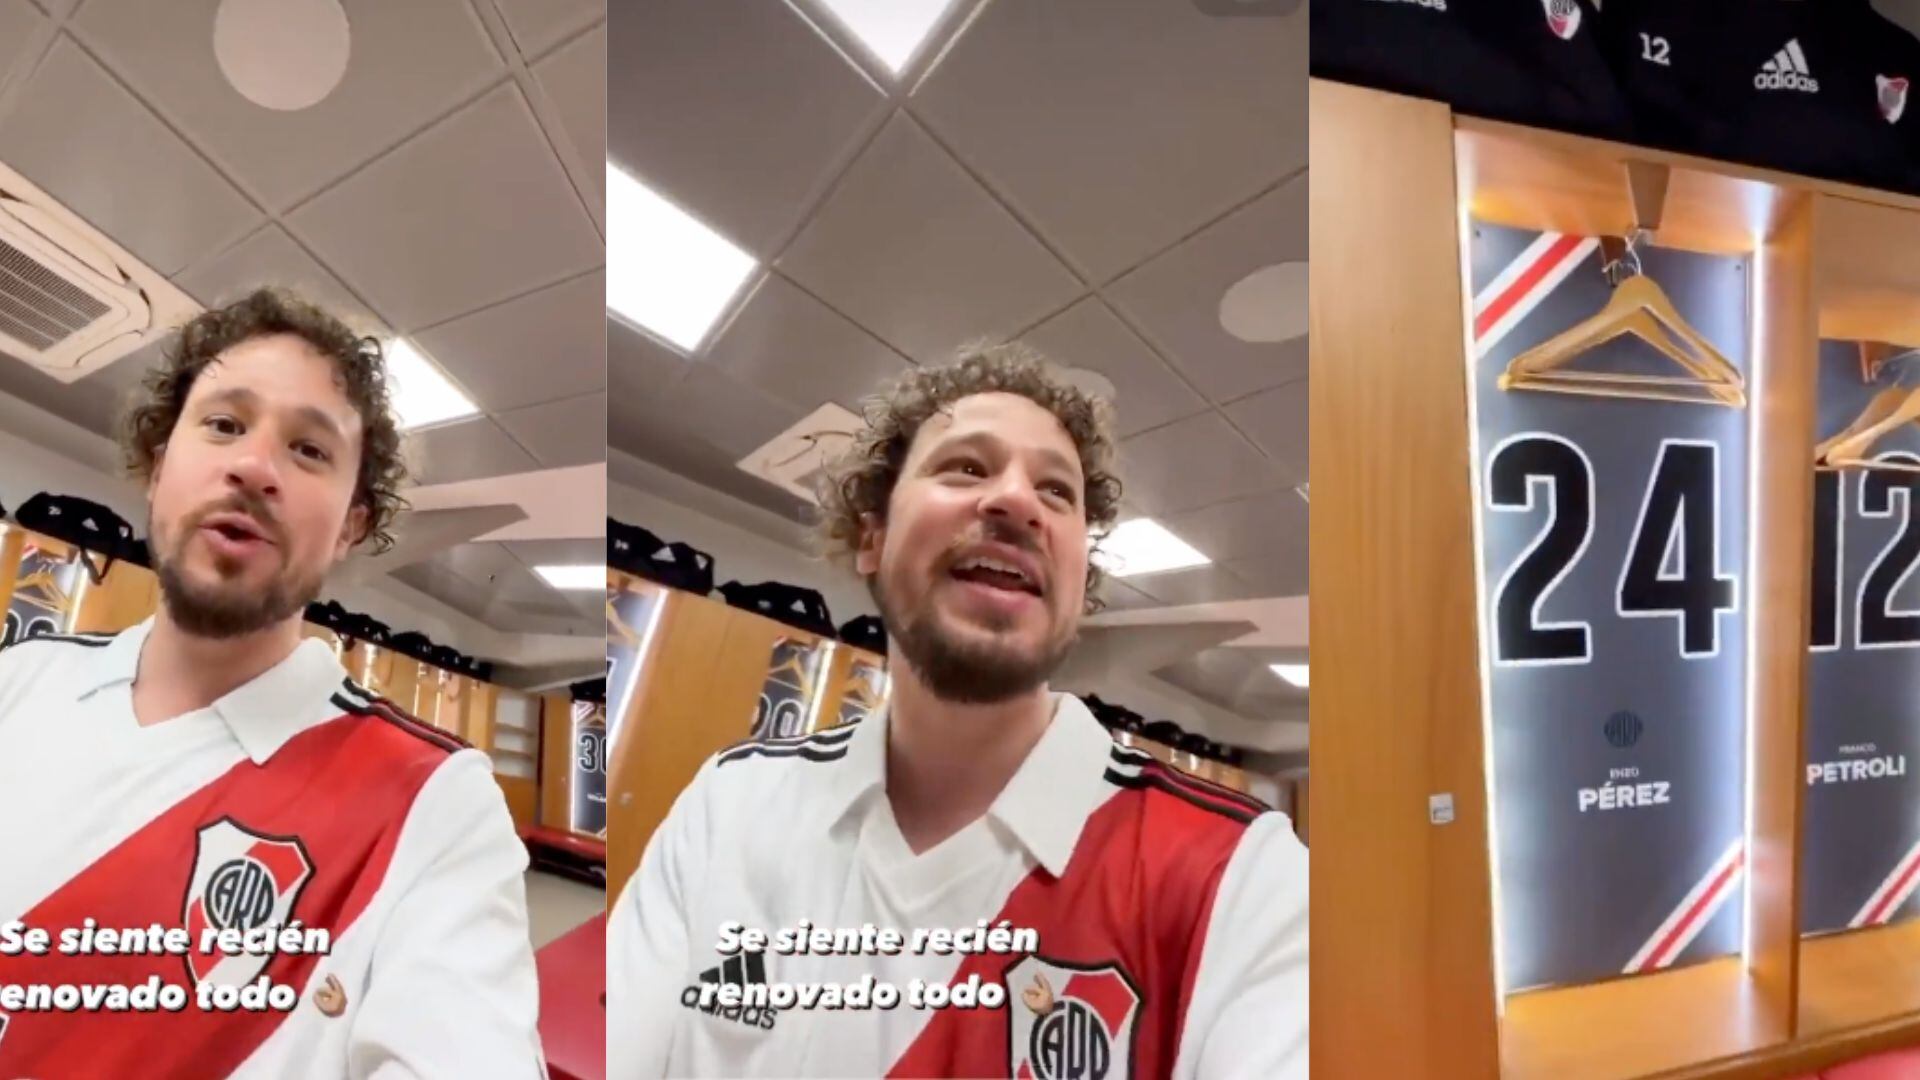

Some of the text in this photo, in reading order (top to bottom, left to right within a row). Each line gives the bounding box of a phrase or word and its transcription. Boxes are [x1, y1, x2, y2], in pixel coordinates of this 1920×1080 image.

[1639, 32, 1671, 66] 12
[1754, 70, 1820, 94] adidas
[1484, 431, 1740, 667] 24
[1806, 755, 1906, 786] PETROLI
[1578, 781, 1671, 812] PÉREZ
